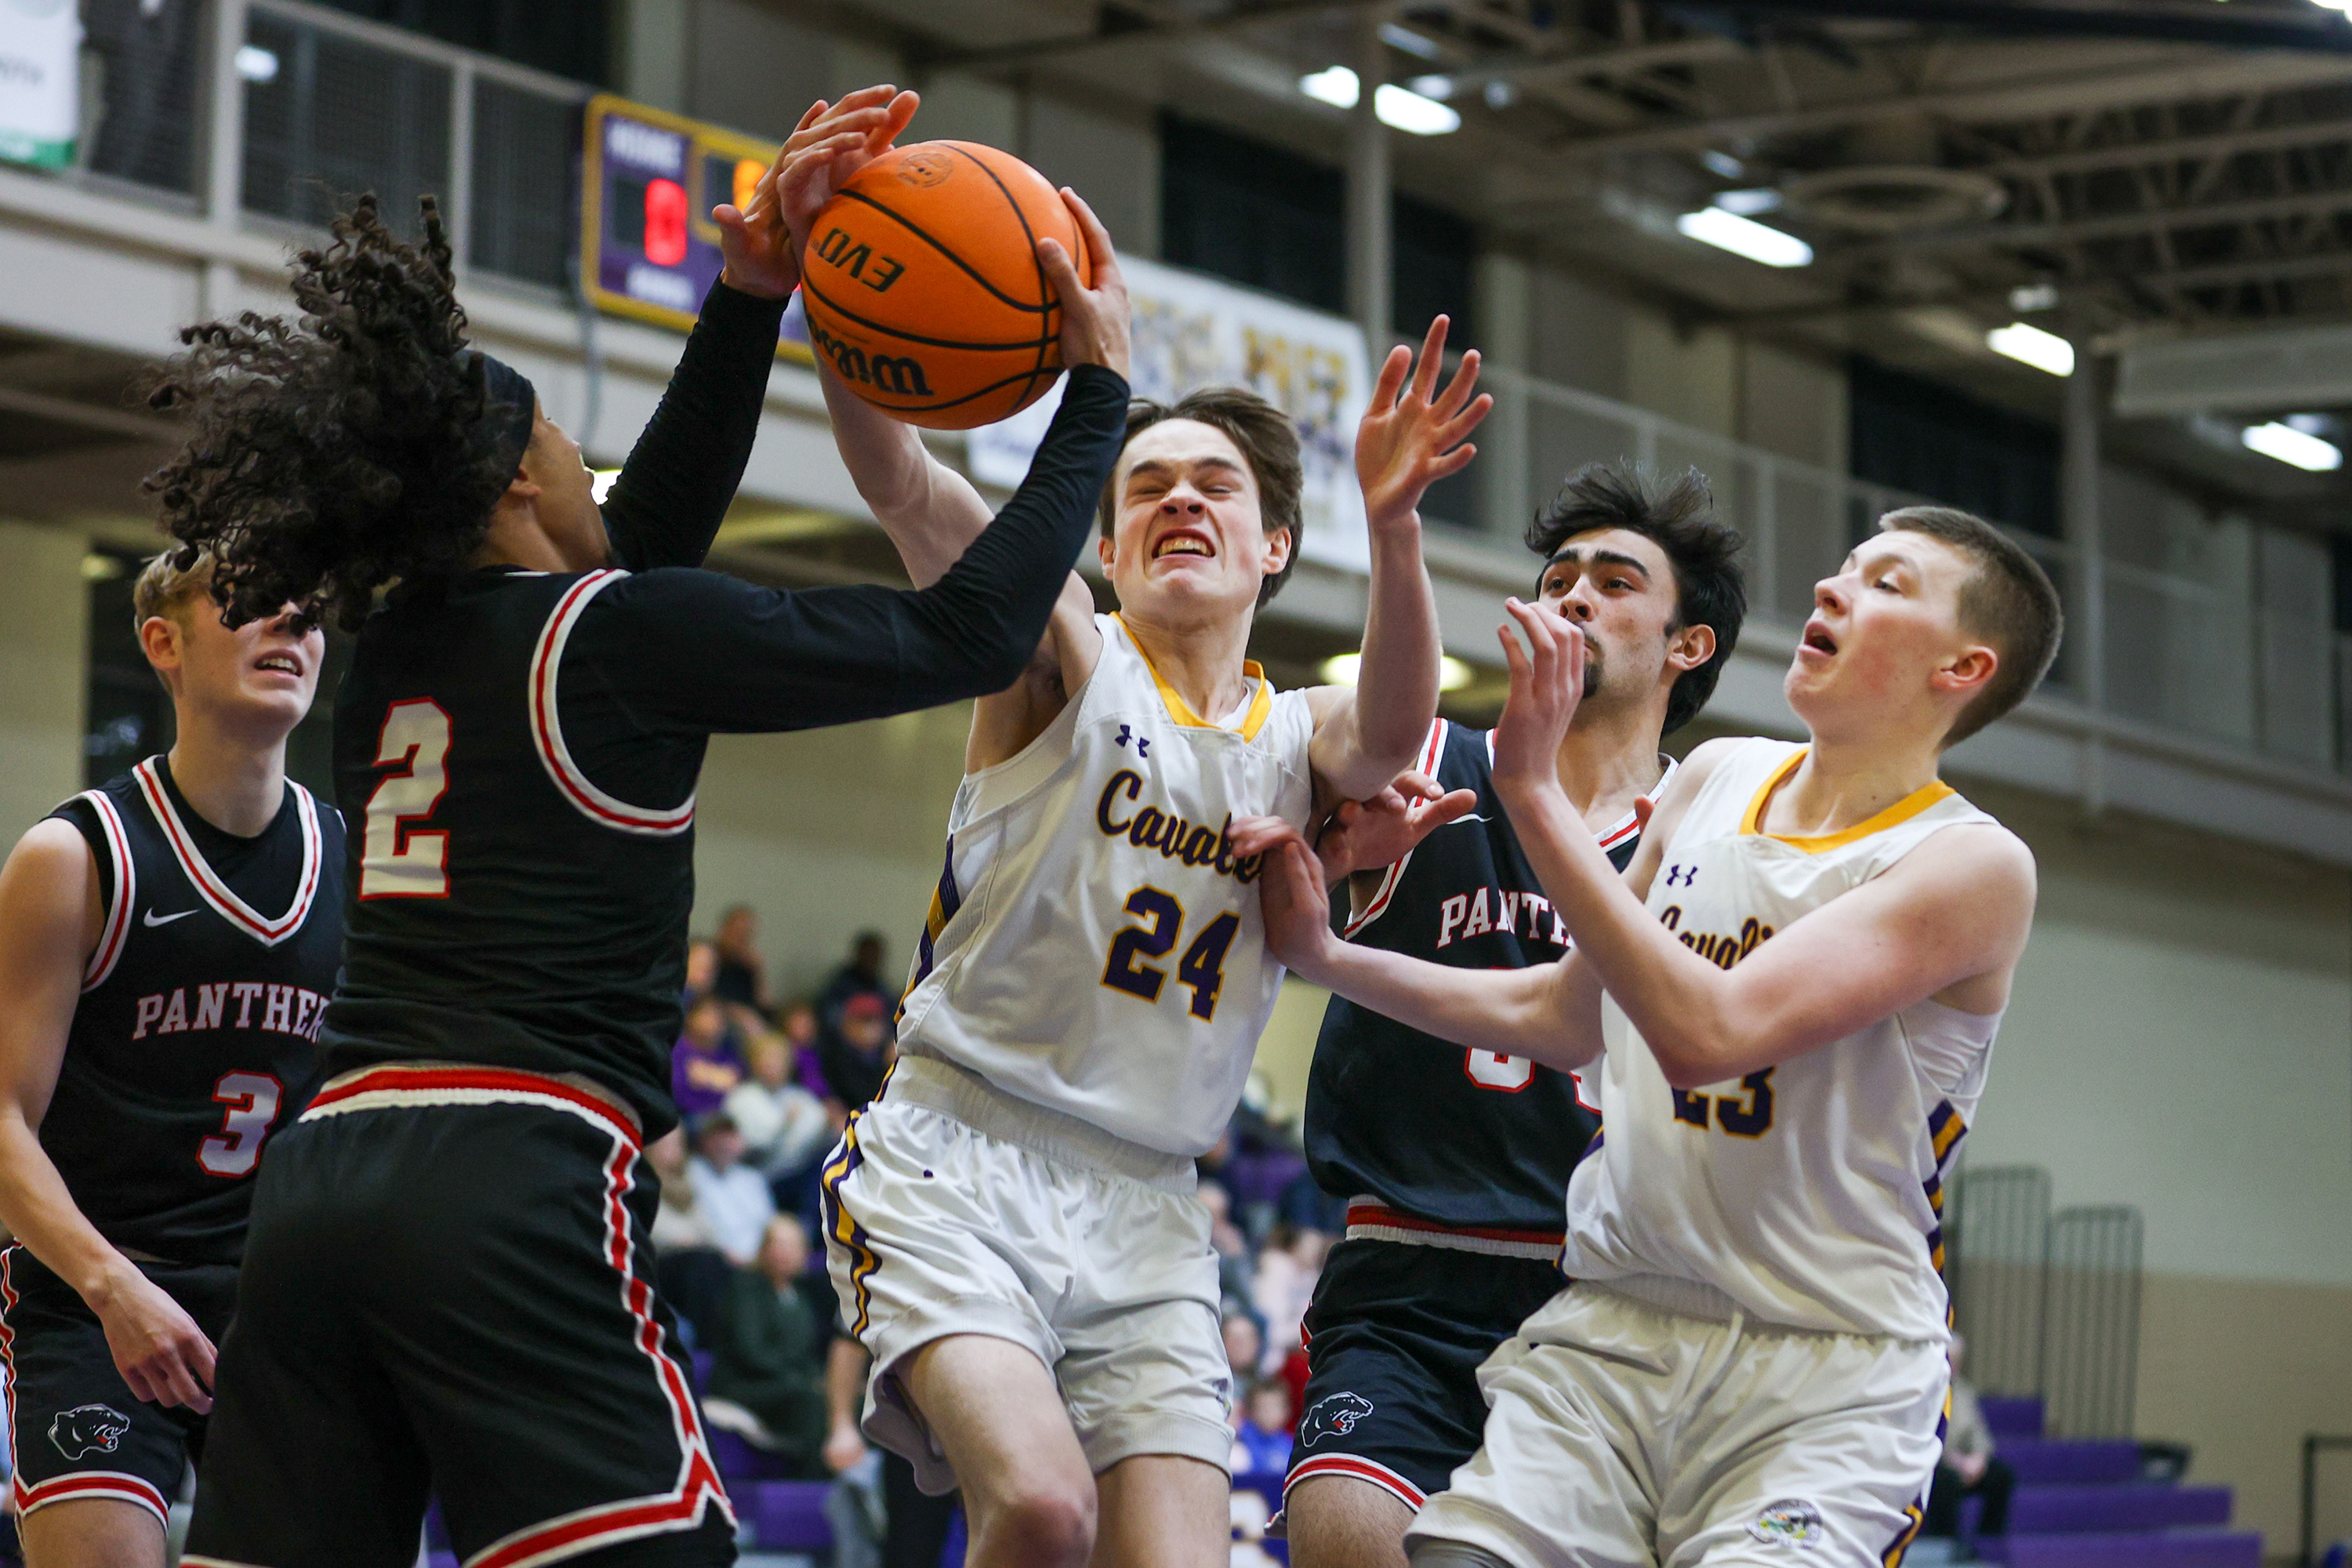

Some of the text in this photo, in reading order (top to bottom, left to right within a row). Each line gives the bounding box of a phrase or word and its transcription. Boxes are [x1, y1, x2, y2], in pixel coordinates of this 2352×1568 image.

[818, 227, 906, 293] EVO
[358, 696, 453, 902] 2
[1099, 883, 1242, 1024] 24
[196, 1069, 285, 1178] 3
